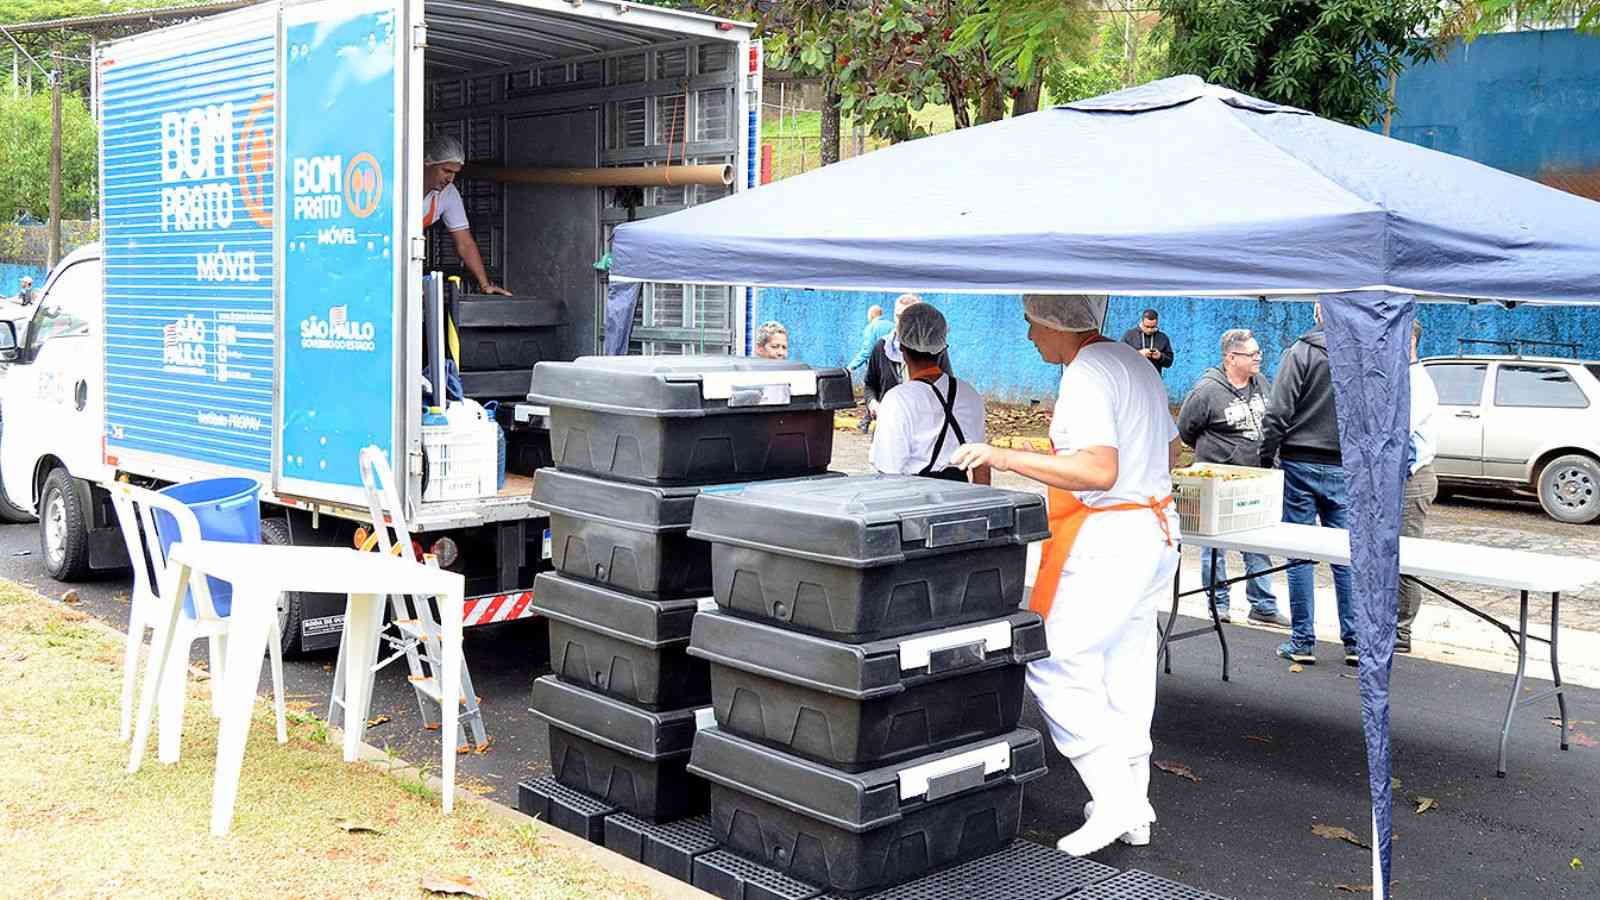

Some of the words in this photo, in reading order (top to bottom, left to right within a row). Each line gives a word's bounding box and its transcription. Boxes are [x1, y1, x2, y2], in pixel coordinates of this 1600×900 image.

[161, 103, 234, 183] BOM
[295, 155, 342, 194] BOM
[161, 182, 234, 232] PRATO
[295, 195, 342, 220] PRATO
[318, 226, 357, 245] MÓVEL
[196, 244, 260, 282] MÓVEL
[175, 314, 206, 342] SÃO
[300, 315, 328, 338] SÃO
[329, 316, 375, 341] PAULO
[163, 343, 206, 367] PAULO
